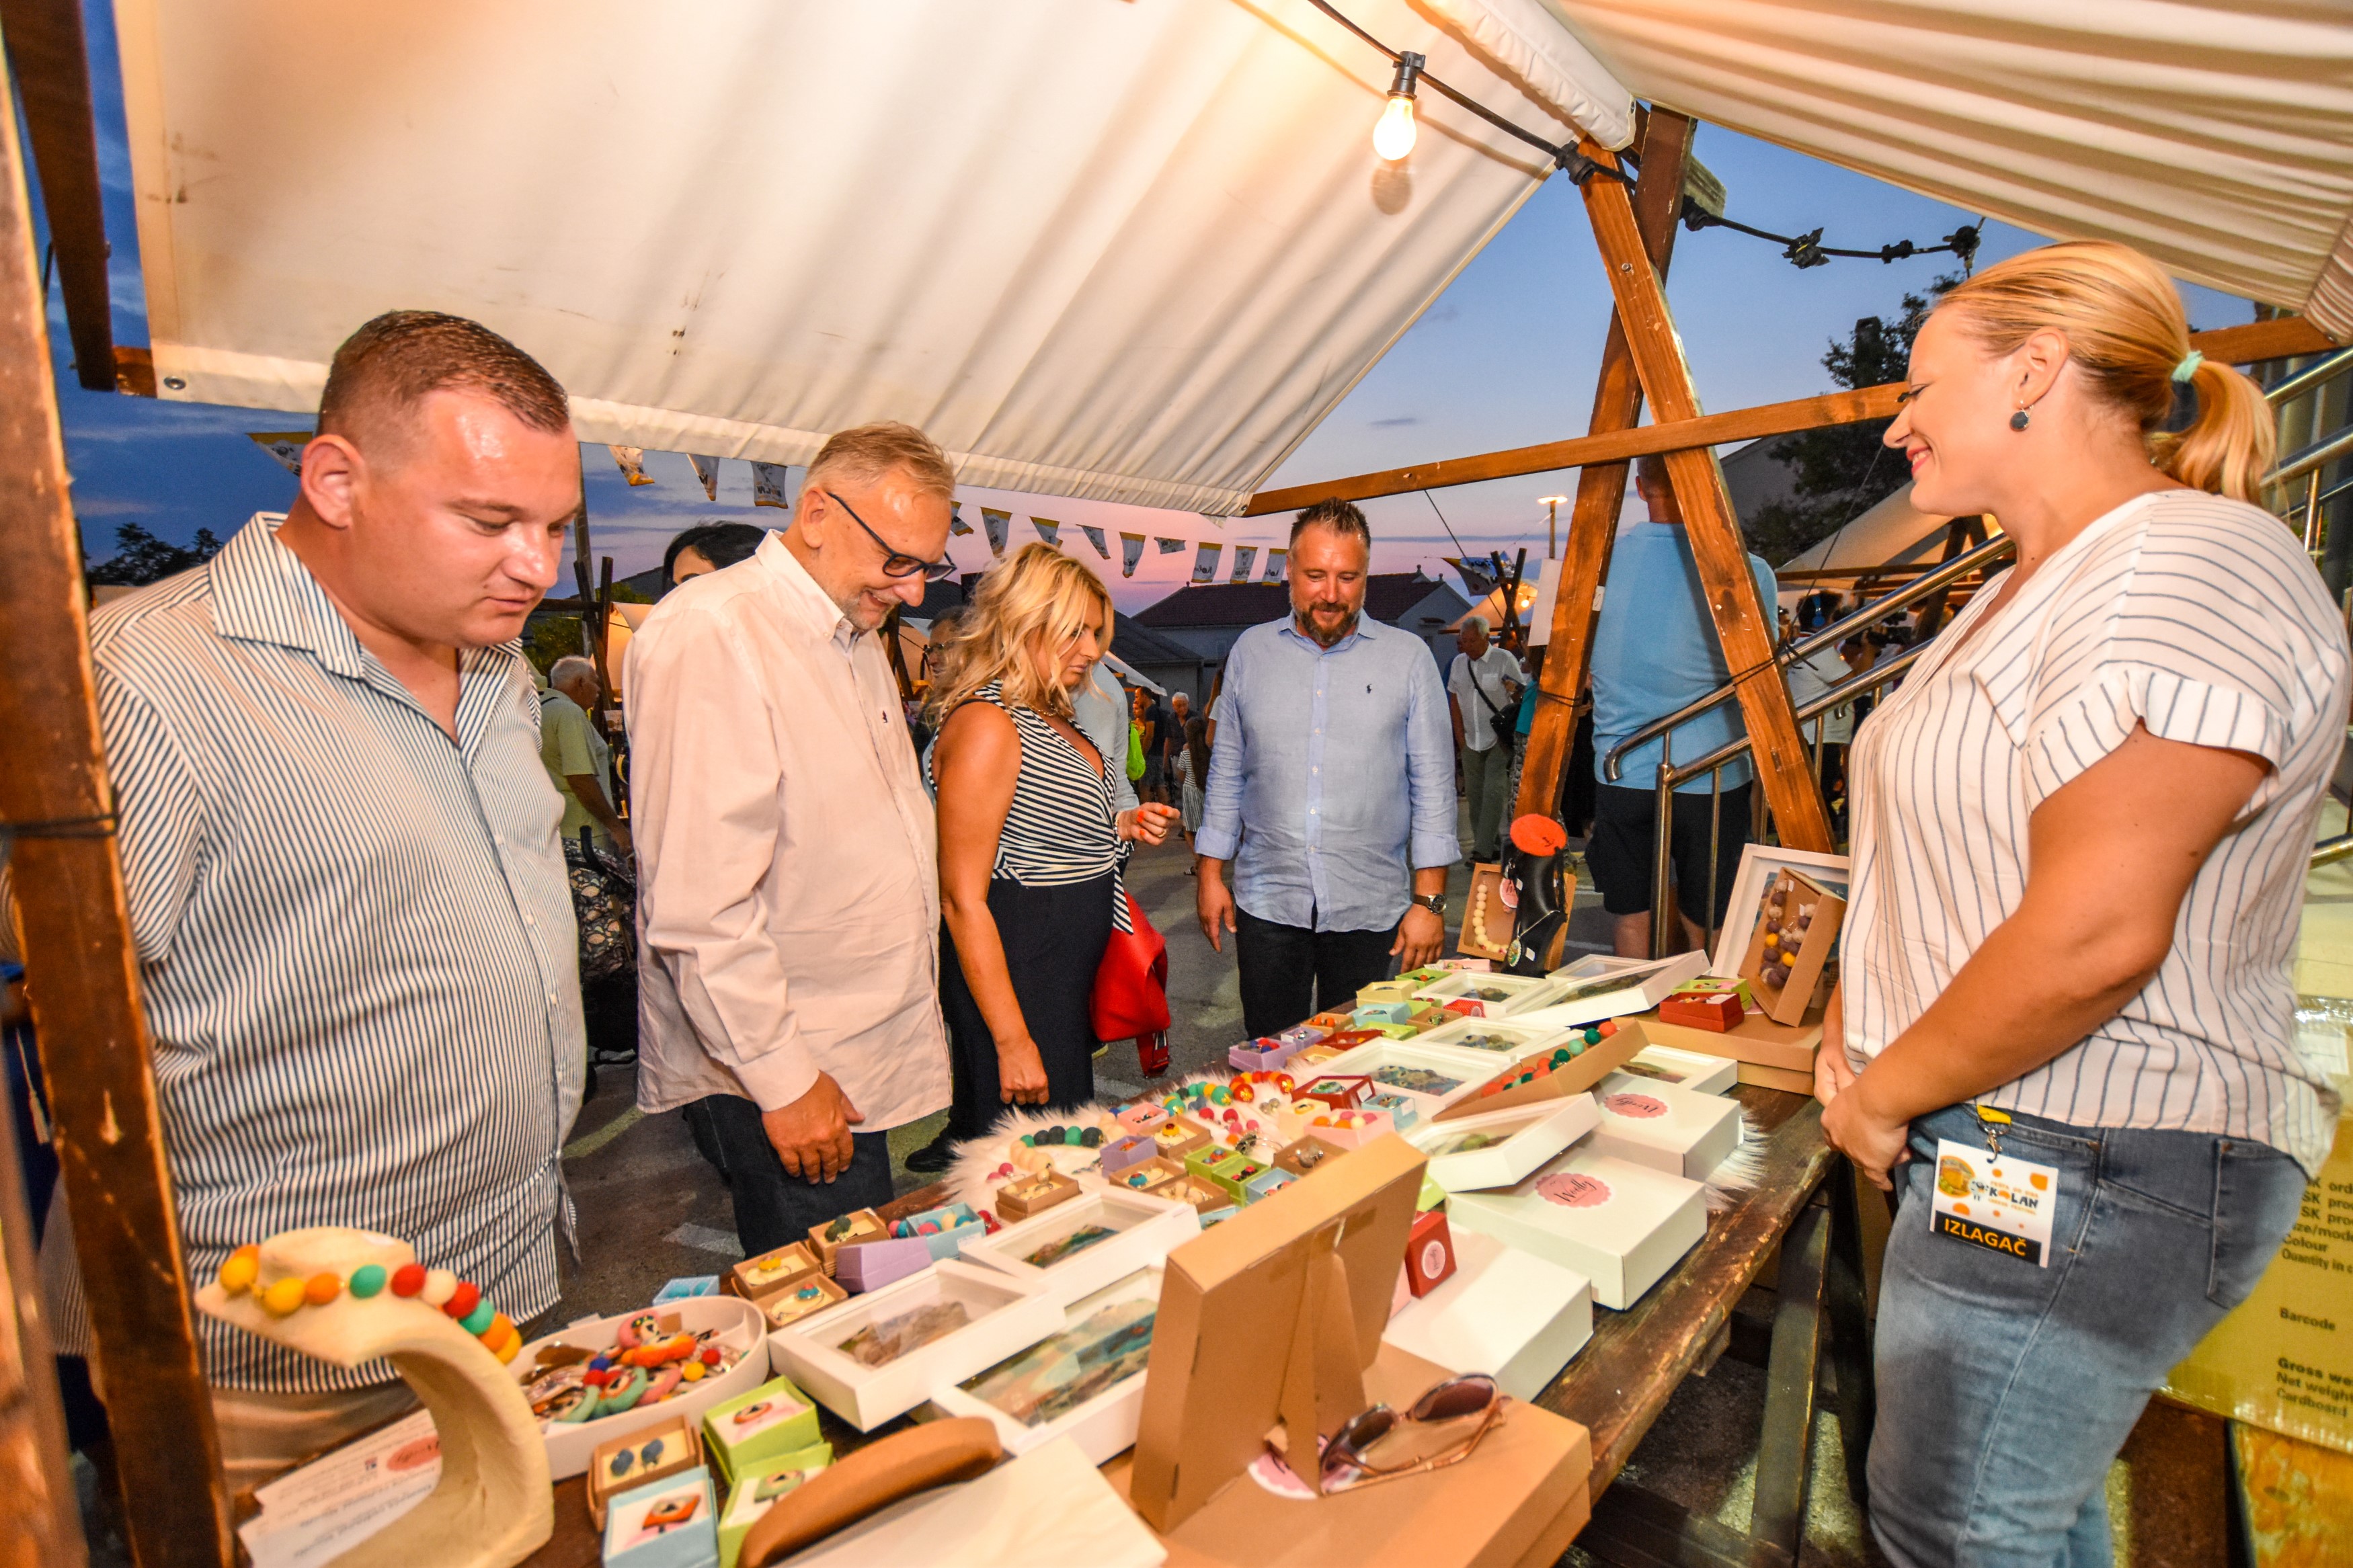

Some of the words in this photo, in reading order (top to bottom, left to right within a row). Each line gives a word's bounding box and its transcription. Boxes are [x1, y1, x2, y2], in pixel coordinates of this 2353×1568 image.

[2328, 1198, 2353, 1210] pro
[2327, 1214, 2353, 1225] pro
[1944, 1218, 2026, 1256] IZLAGAČ
[2282, 1248, 2329, 1270] Quantity
[2280, 1307, 2335, 1331] Barcode
[2276, 1371, 2300, 1387] Net
[2278, 1357, 2323, 1378] Gross
[2329, 1373, 2353, 1387] we
[2277, 1387, 2347, 1418] Cardboard
